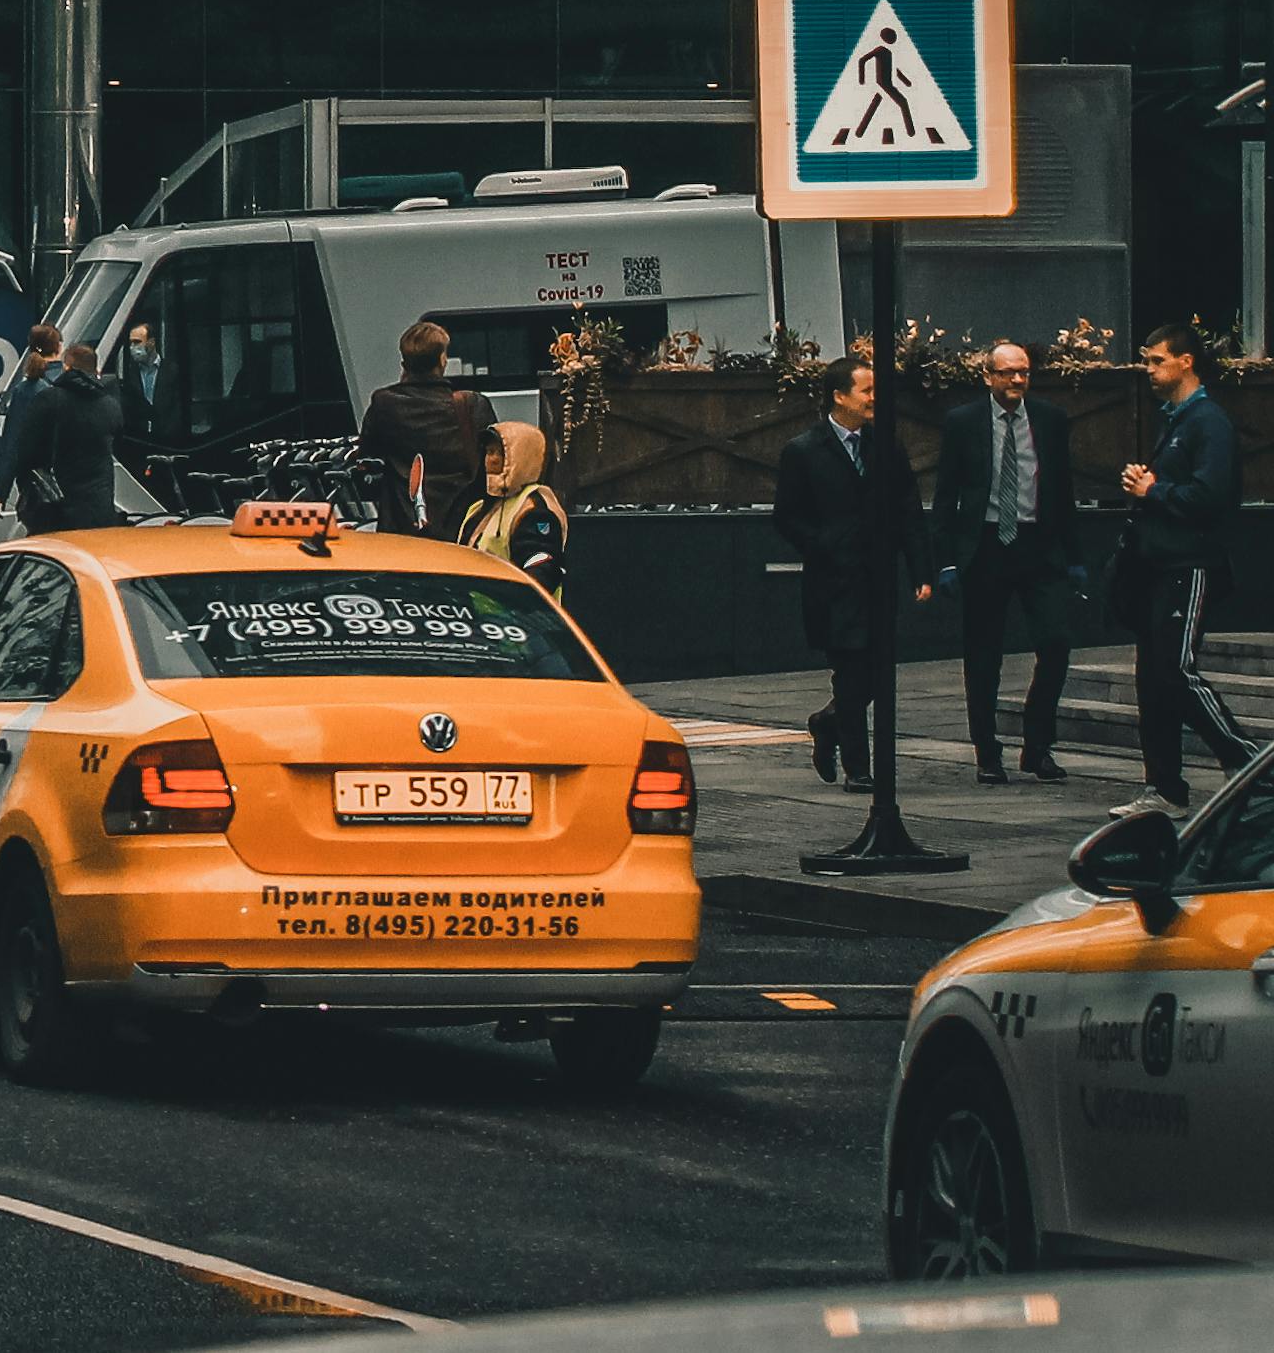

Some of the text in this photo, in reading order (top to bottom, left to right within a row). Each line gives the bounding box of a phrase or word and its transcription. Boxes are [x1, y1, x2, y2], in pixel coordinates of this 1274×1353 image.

[545, 252, 589, 269] ТЕСТ
[562, 272, 577, 282] на
[537, 284, 604, 301] Covid-19
[206, 597, 474, 621] Яндекс Go Такси
[164, 617, 528, 644] +7 (495) 999 99 99
[408, 776, 469, 807] 559
[488, 775, 520, 799] 77
[494, 800, 517, 809] RUS
[261, 885, 606, 911] Приглашаем водителей
[276, 914, 580, 940] тел. 8(495) 220-31-56
